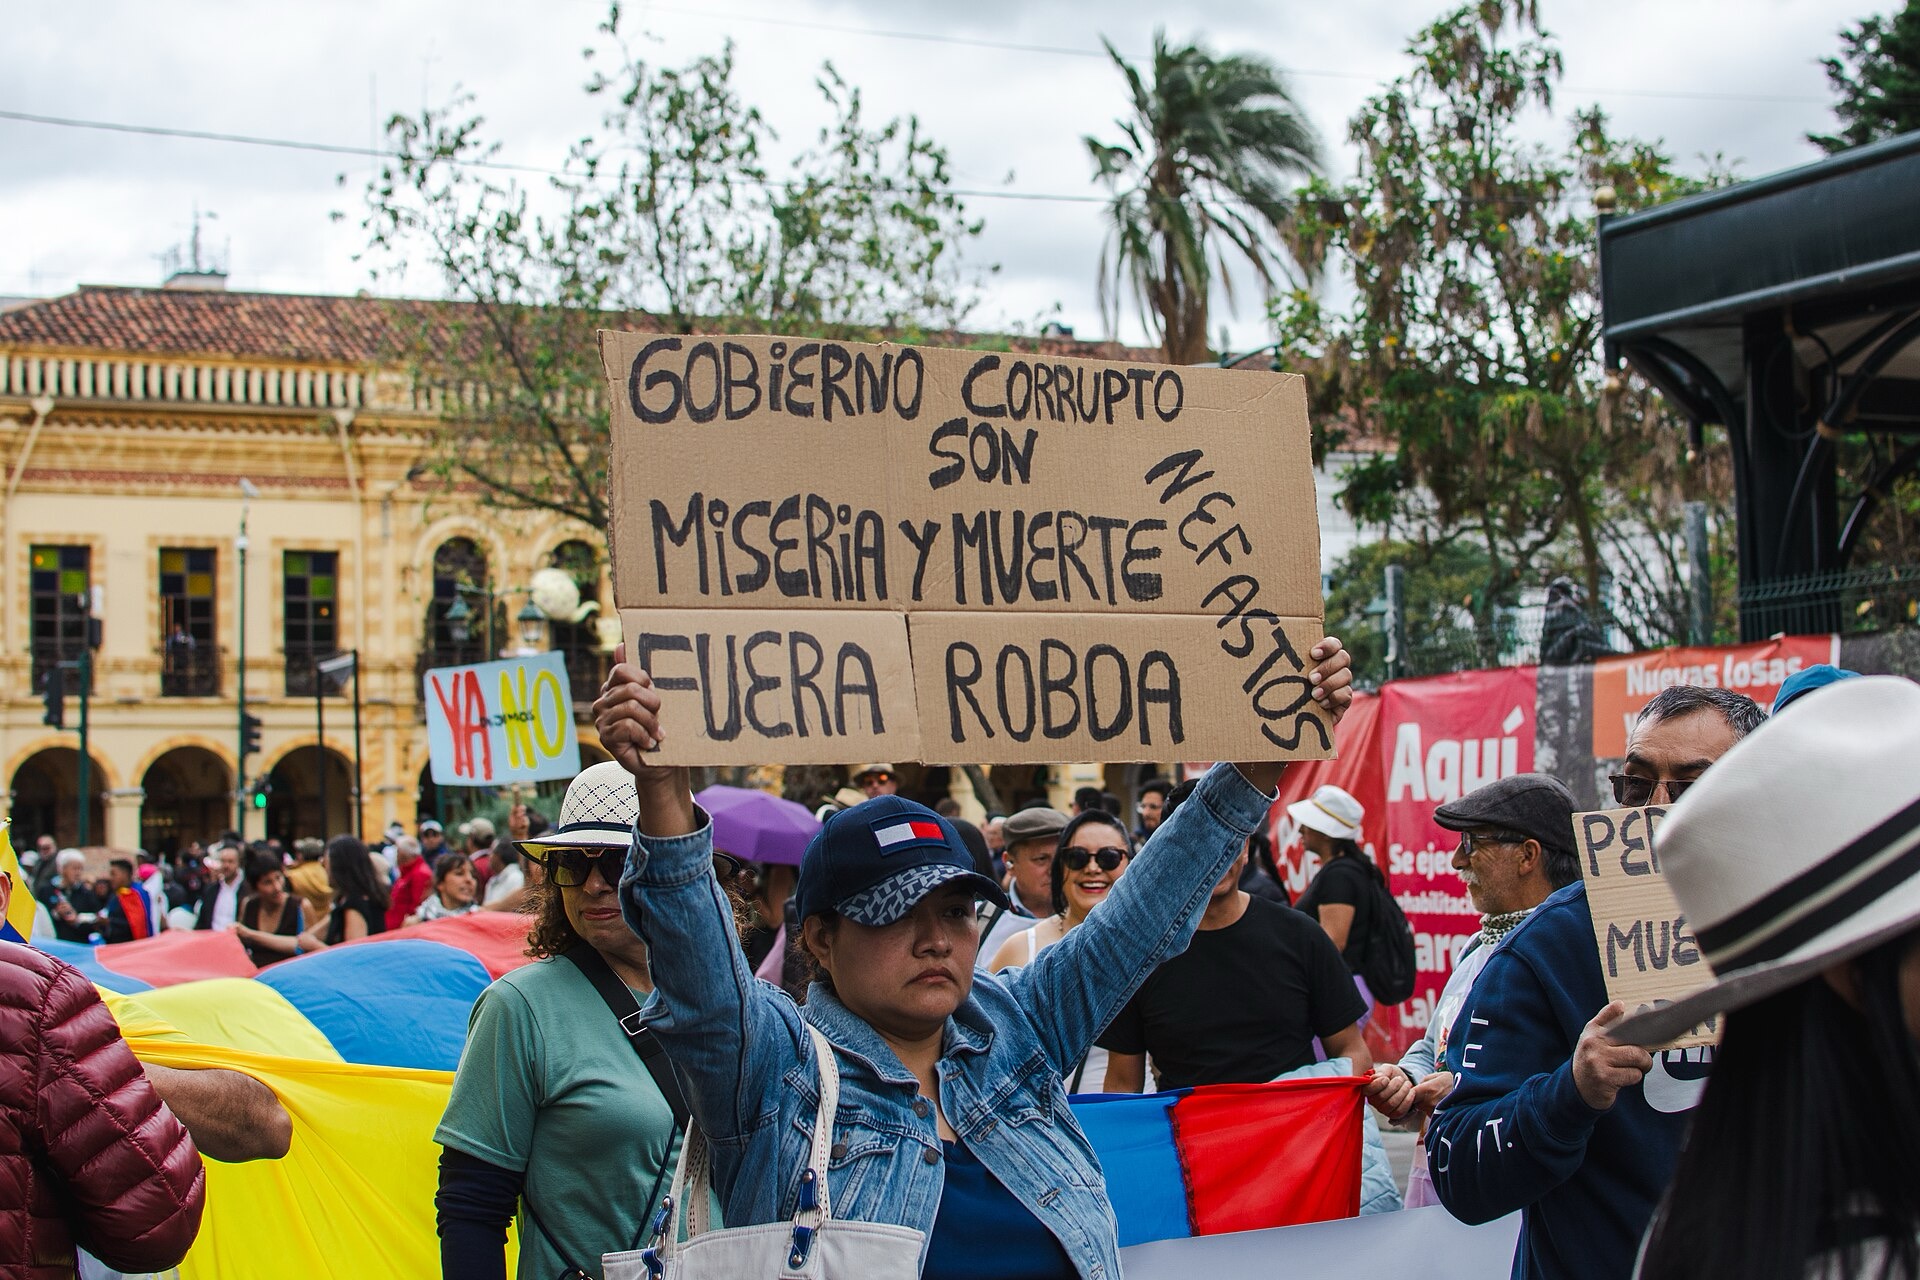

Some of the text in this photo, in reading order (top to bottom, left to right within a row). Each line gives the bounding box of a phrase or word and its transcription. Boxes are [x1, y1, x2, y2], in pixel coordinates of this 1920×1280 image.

[961, 355, 1185, 425] CORRUPTO
[928, 417, 1038, 490] SON
[899, 519, 941, 601] Y
[954, 510, 1168, 605] MUERTE
[638, 630, 1185, 752] FUERA ROBOA
[1626, 654, 1803, 697] Nuevas losas
[432, 670, 492, 781] YA
[499, 665, 567, 769] NO
[1387, 705, 1525, 803] Aquí
[1389, 843, 1415, 875] Se
[1606, 916, 1700, 977] MUE
